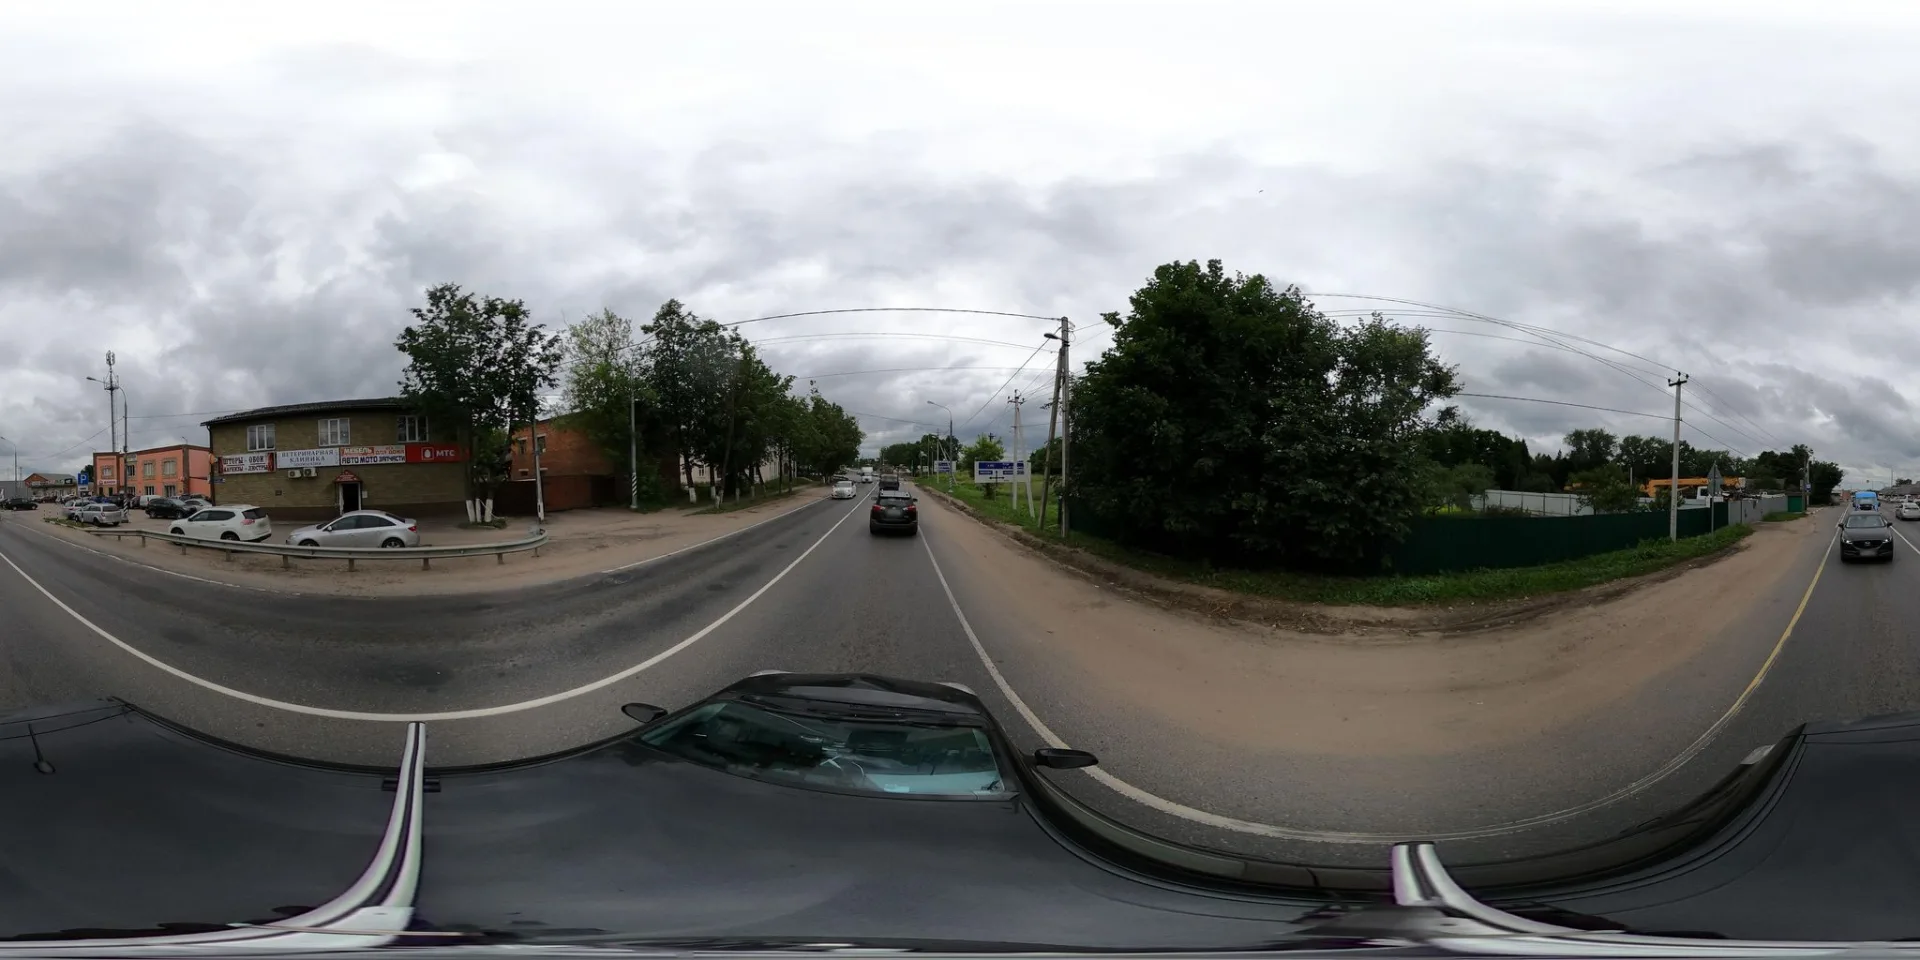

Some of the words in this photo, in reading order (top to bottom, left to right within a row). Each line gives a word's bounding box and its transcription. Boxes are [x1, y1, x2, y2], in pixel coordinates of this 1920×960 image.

[281, 449, 334, 458] ВЕТЕРИНАРНАЯ
[436, 449, 455, 457] МТС
[223, 457, 244, 465] ШТОРЫ
[248, 455, 264, 463] ОБОИ
[341, 456, 359, 464] АВТО
[360, 455, 378, 463] МОТО
[379, 454, 405, 462] ЗАПЧАСТИ
